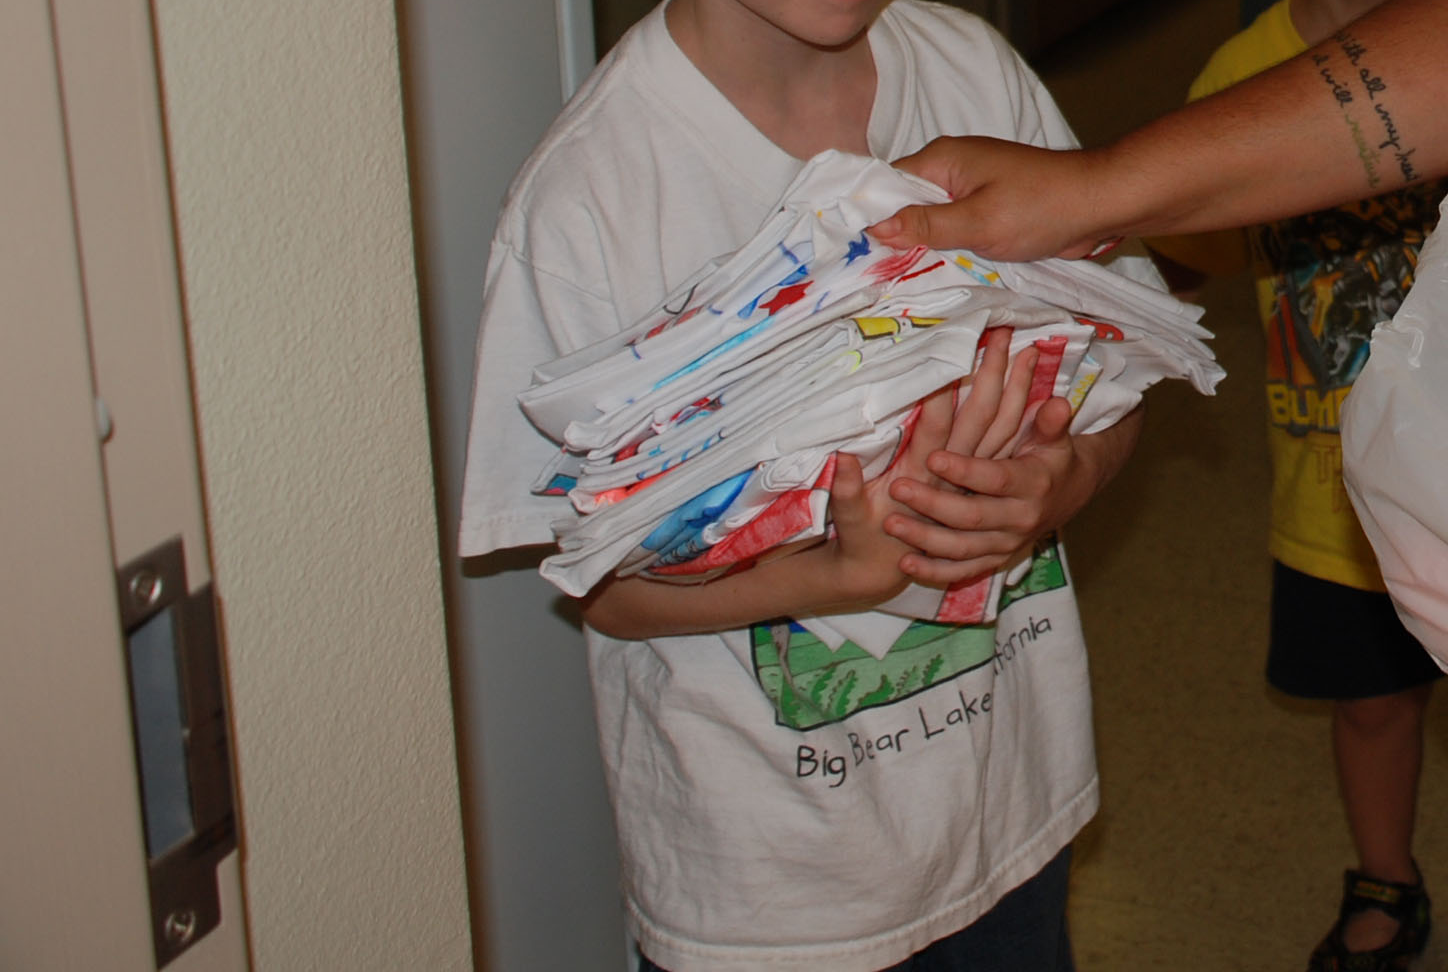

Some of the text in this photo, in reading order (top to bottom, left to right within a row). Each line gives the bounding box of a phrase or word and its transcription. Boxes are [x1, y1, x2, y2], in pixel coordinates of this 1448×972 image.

[1320, 68, 1352, 108] will
[1360, 68, 1386, 100] all
[1375, 104, 1402, 150] my
[796, 745, 847, 788] Big
[848, 728, 909, 767] Bear
[919, 690, 993, 740] Lake
